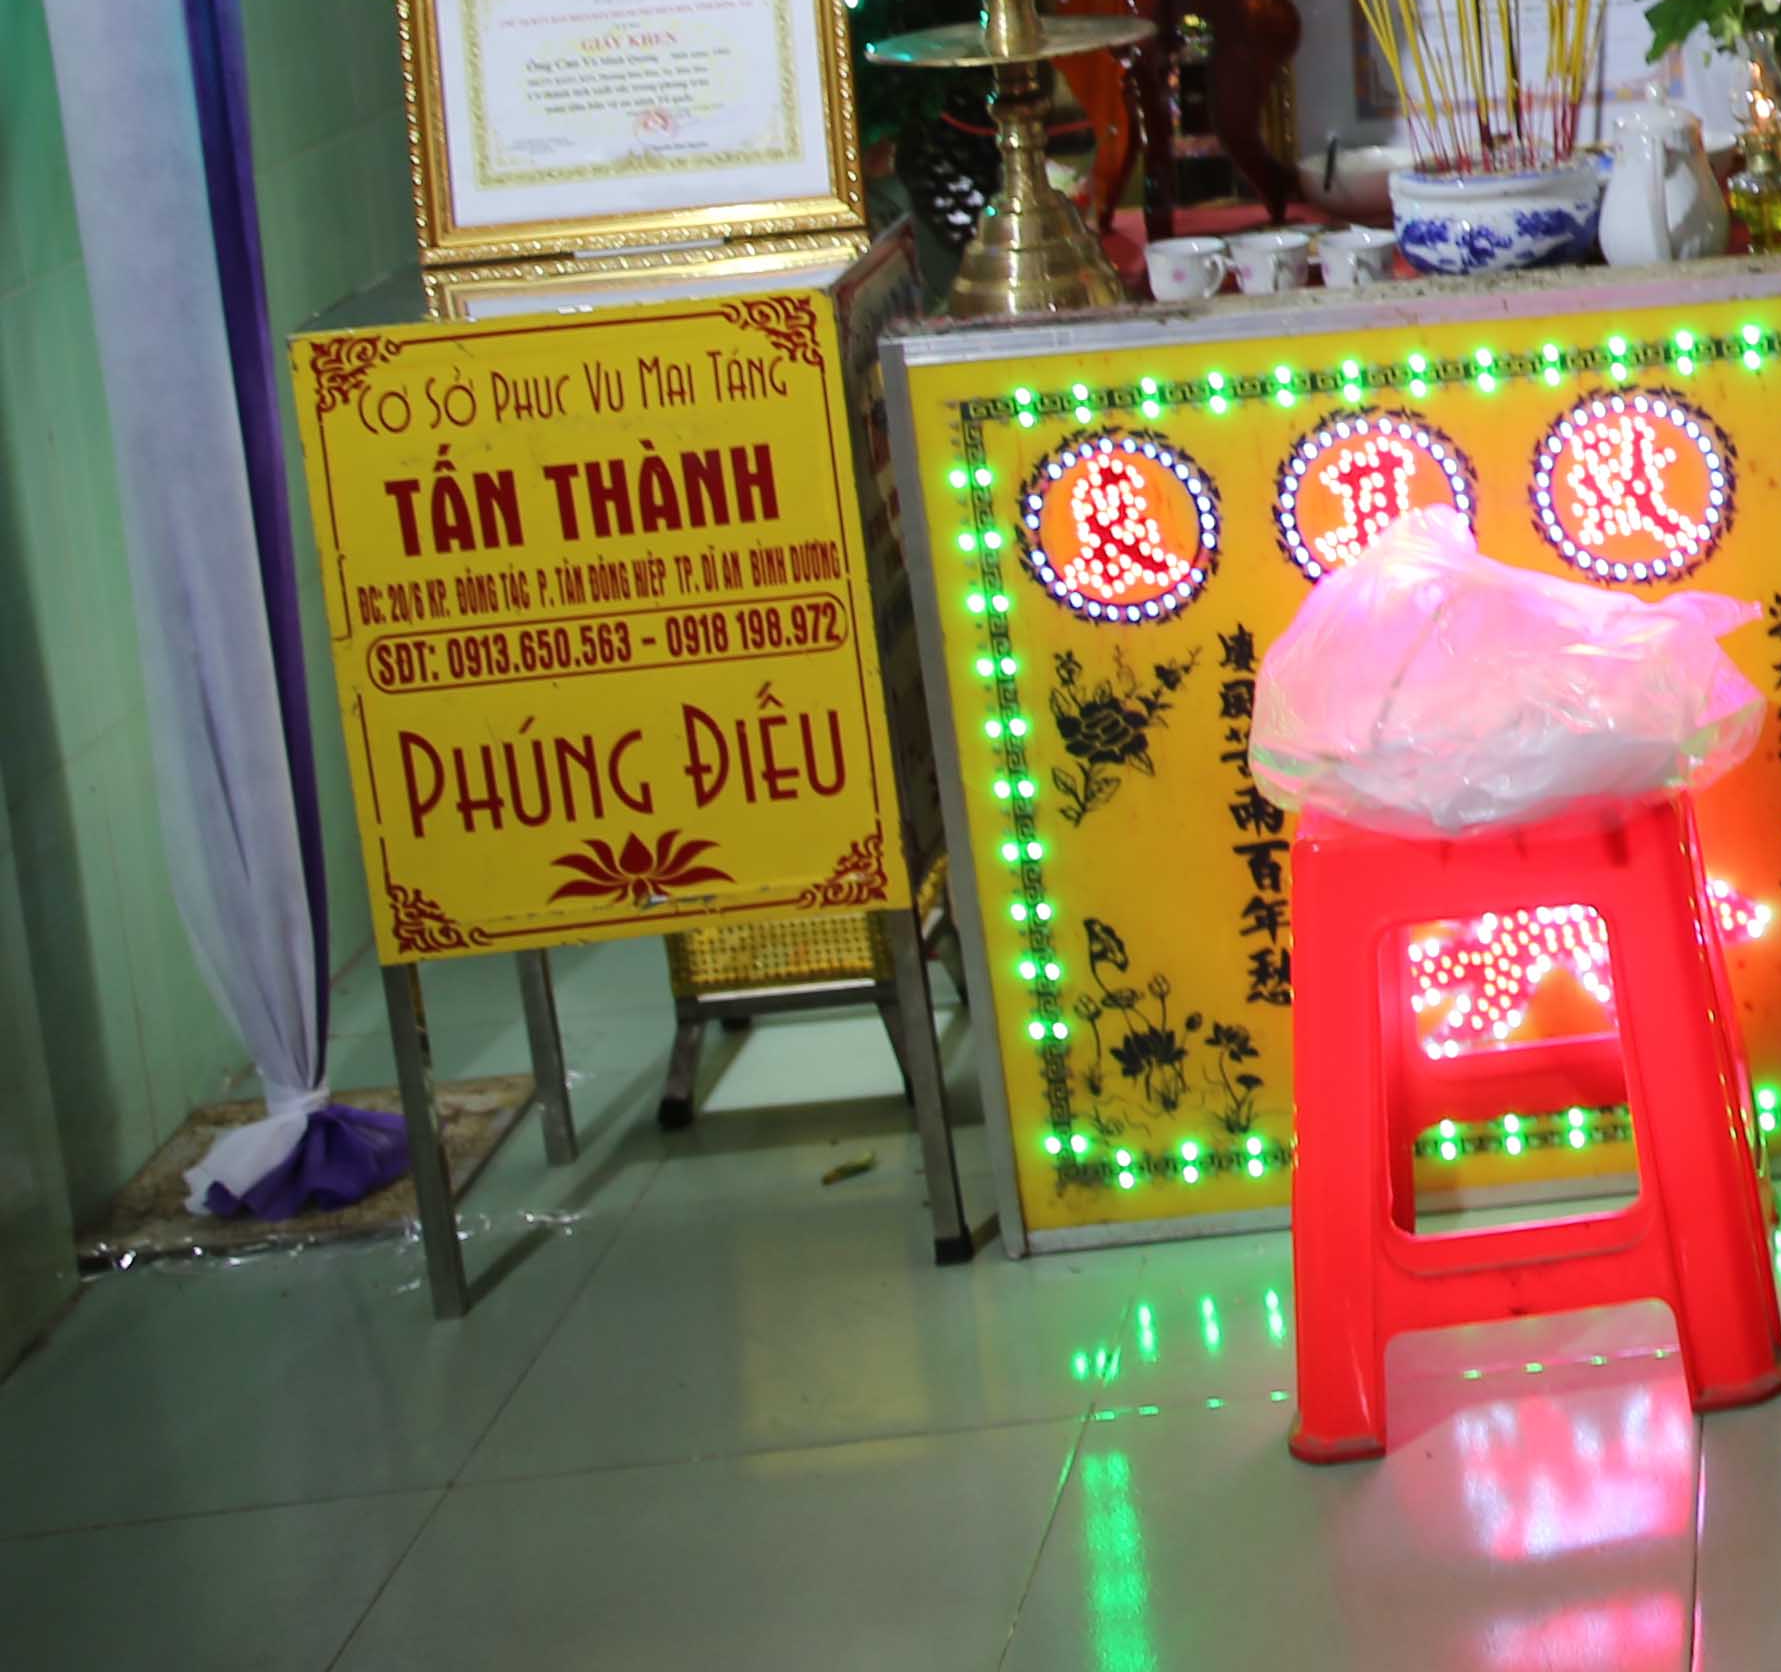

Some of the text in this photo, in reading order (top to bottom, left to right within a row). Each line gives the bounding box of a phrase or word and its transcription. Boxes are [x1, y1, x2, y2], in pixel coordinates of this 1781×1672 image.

[637, 356, 696, 409] MAI
[384, 438, 780, 557] TẤN THÀNH
[376, 640, 440, 686] SĐT:
[447, 622, 632, 680] 0913.650.563
[665, 612, 729, 658] 0918
[736, 602, 842, 650] 198.972
[397, 681, 847, 839] PHÚNG ĐIẾU
